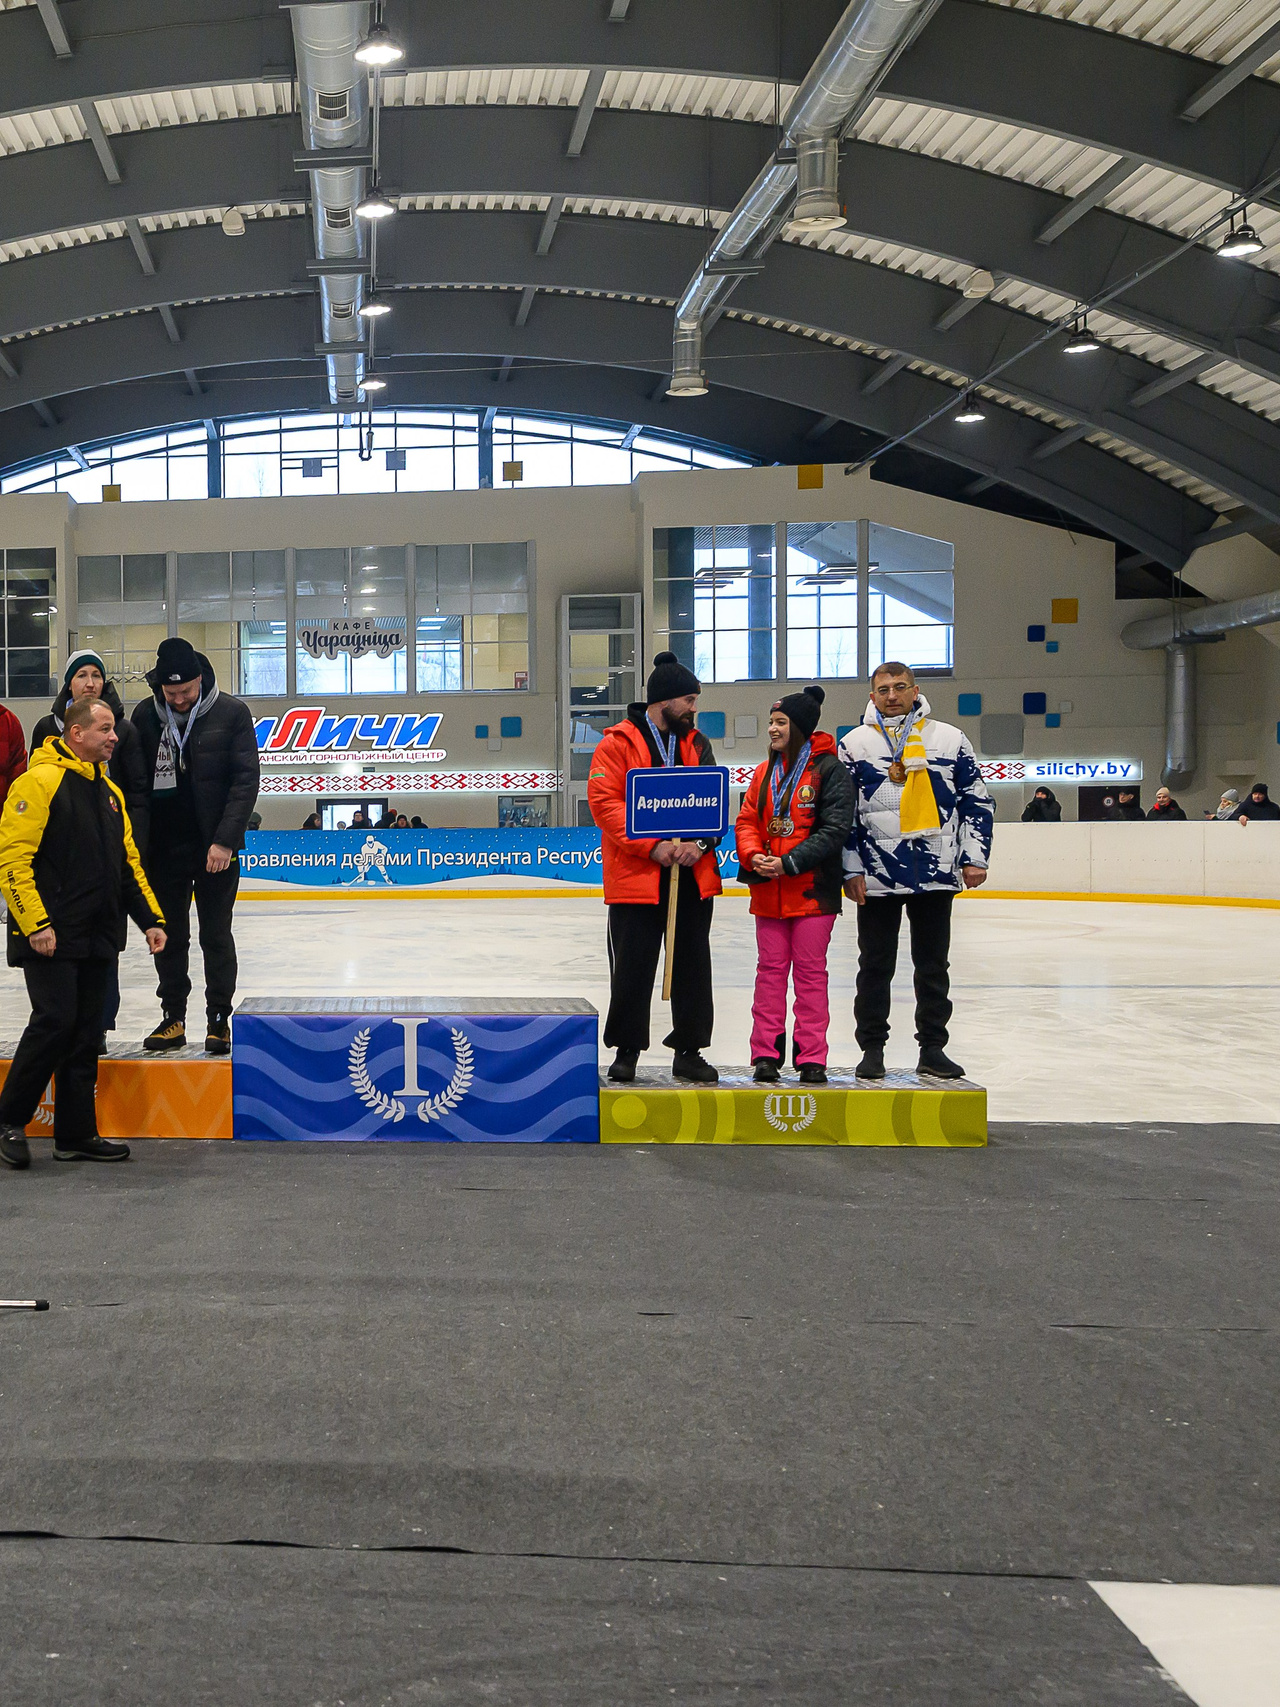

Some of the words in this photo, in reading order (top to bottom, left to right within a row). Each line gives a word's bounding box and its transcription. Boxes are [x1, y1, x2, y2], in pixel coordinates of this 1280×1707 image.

[333, 622, 371, 631] КАФЕ
[259, 752, 307, 762] АНСКИЙ
[309, 752, 404, 762] ГОРНОЛЫЖНЫЙ
[406, 752, 444, 762] ЦЕНТР
[1036, 762, 1131, 777] silichy.by
[637, 793, 718, 812] Агрохолдинг
[239, 852, 337, 871] правления
[341, 852, 412, 870] делами
[417, 848, 532, 870] Президента
[537, 846, 603, 869] Респуб
